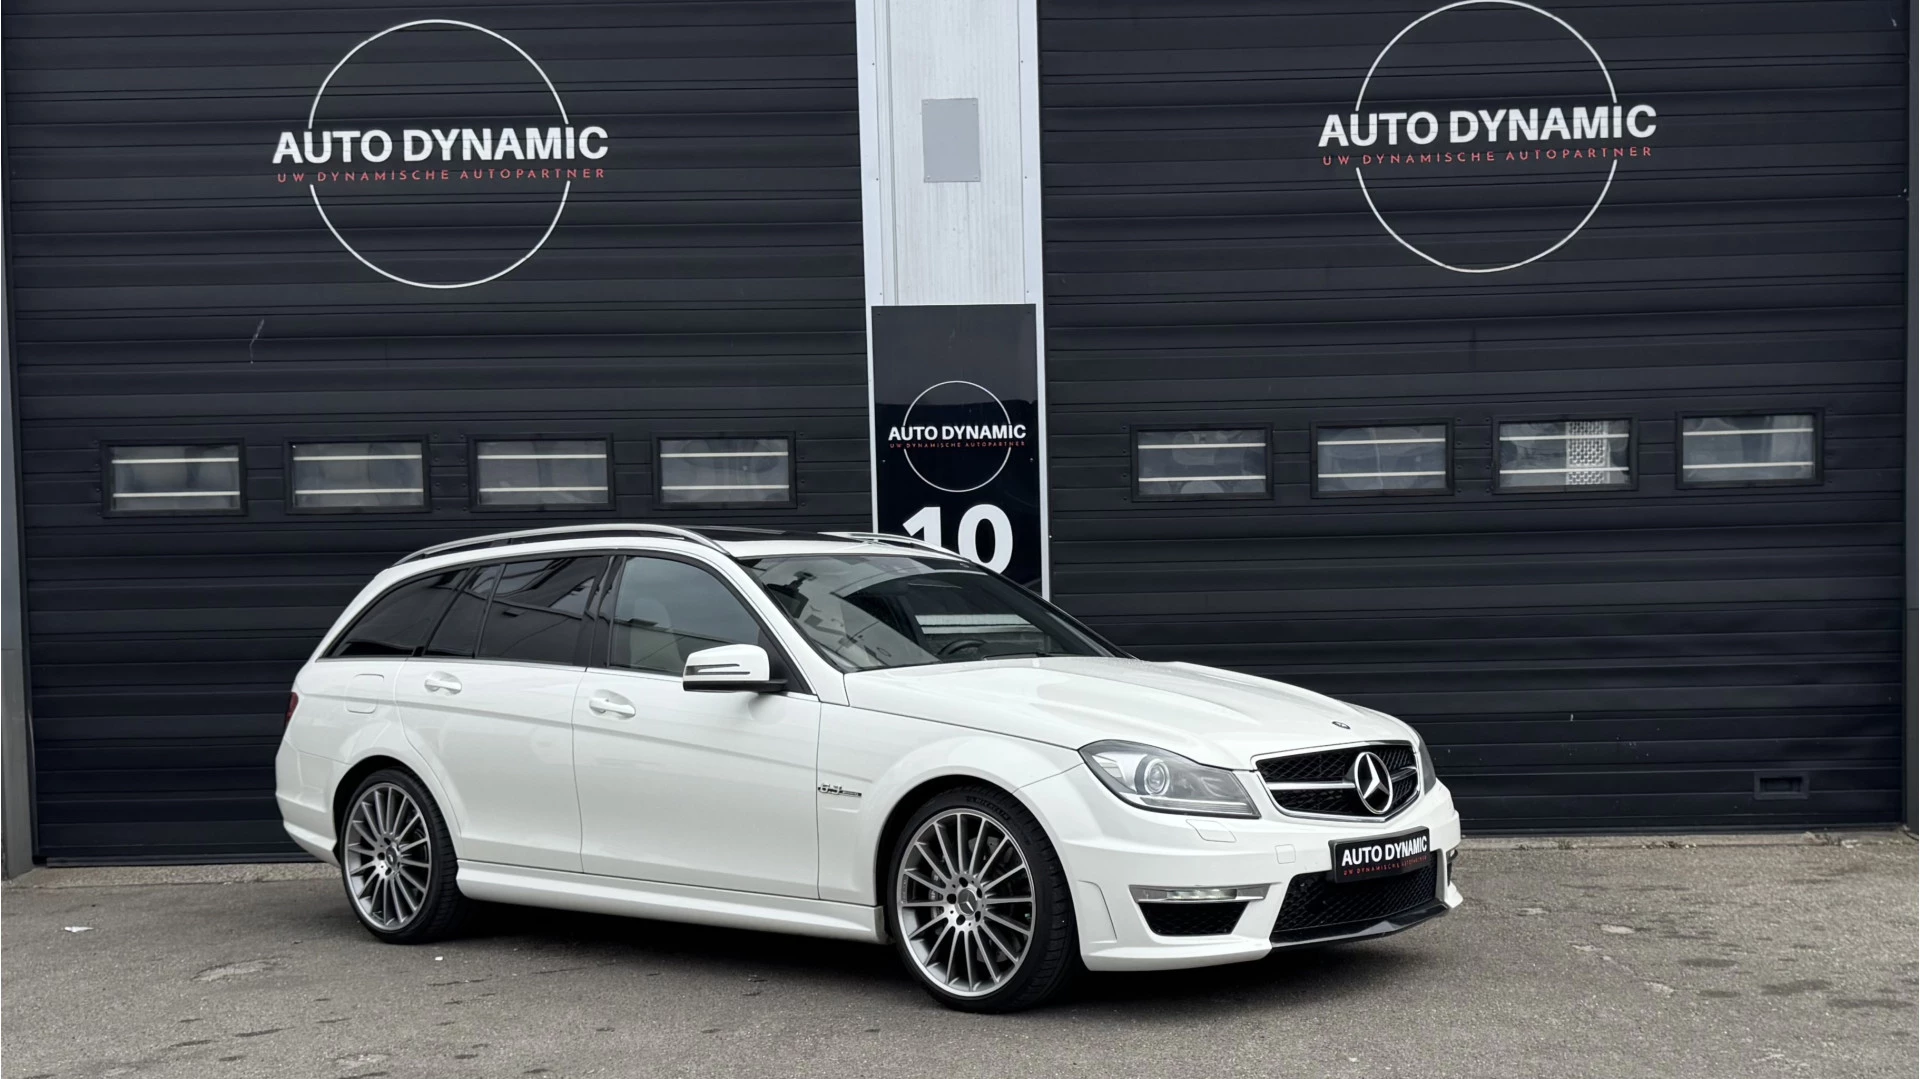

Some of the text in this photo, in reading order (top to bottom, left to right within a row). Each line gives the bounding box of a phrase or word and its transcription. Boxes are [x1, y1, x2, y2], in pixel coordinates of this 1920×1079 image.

[1318, 105, 1657, 147] AUTO DYNAMIC
[272, 126, 609, 164] AUTO DYNAMIC
[1322, 146, 1652, 166] UW DYNAMISCHE AUTOPARTNER
[278, 168, 605, 184] UW DYNAMISCHE AUTOPARTNER
[888, 424, 1027, 441] AUTO DYNAMIC
[902, 504, 1014, 574] 10
[1341, 845, 1383, 867] AUTO
[1385, 835, 1428, 860] DYNAMIC
